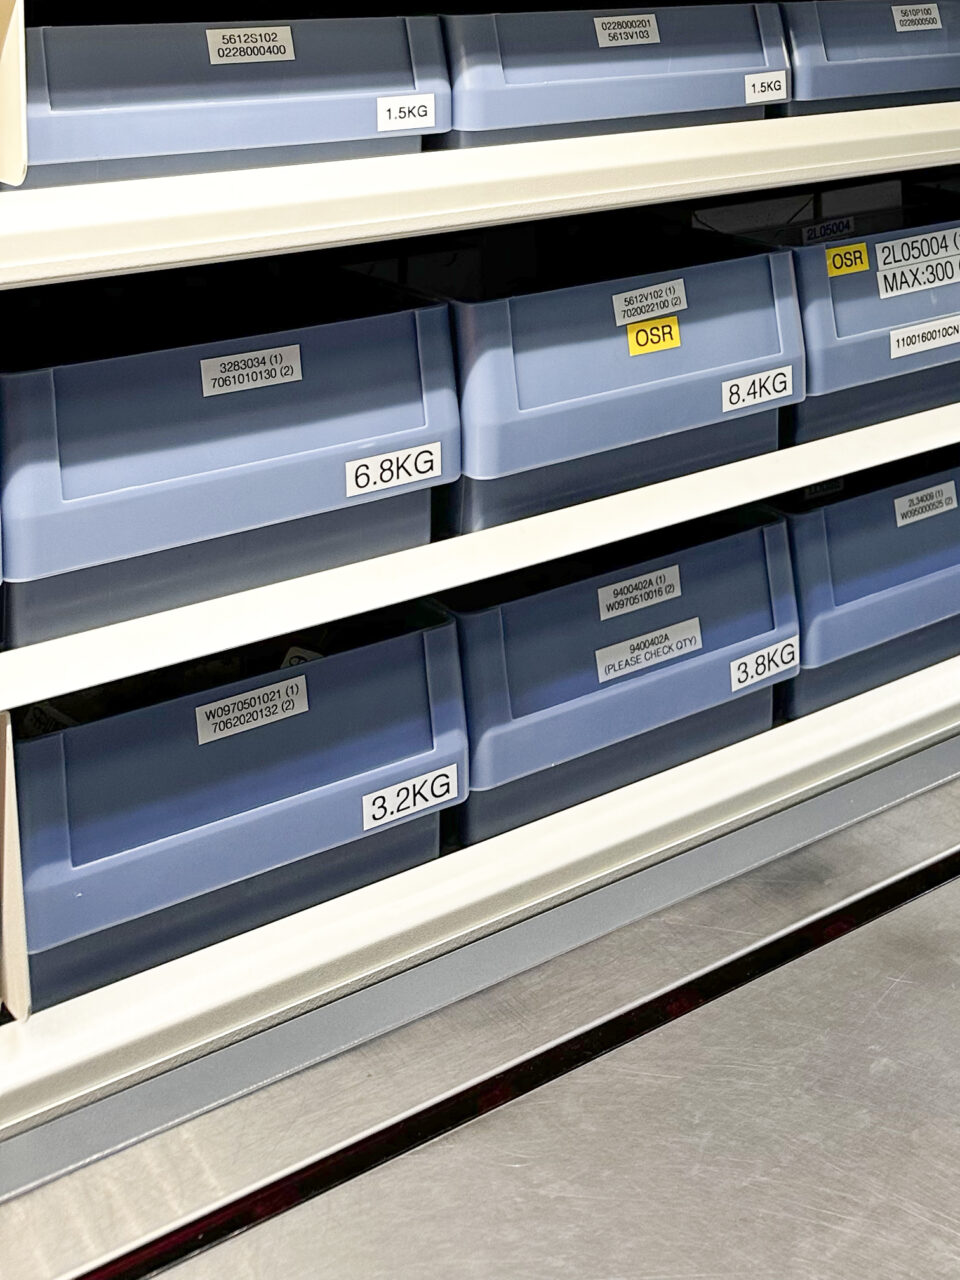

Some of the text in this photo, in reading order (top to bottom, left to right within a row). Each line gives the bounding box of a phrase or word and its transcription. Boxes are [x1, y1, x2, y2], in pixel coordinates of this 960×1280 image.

[601, 19, 651, 32] 0228000201
[607, 29, 650, 42] 5613V103
[217, 44, 287, 58] 0228000400
[221, 32, 279, 45] 5612S102
[751, 79, 782, 95] 1.5KG
[385, 104, 428, 121] 1.5KG
[832, 251, 864, 270] OSR
[881, 234, 949, 266] 2L05004
[883, 261, 955, 294] MAX:300
[621, 296, 682, 319] 7020022100 (2)
[624, 285, 676, 308] 5612V102 (1)
[635, 323, 674, 348] OSR
[896, 324, 960, 350] 1100160010CN
[219, 352, 283, 374] 3283034 (1)
[211, 364, 294, 389] 7061010130 (2)
[728, 372, 787, 406] 8.4KG
[354, 450, 435, 490] 6.8KG
[935, 488, 944, 499] (1)
[606, 582, 675, 613] W0970510016 (2)
[612, 574, 666, 599] 9400402A (1)
[604, 635, 697, 676] (PLEASE CHECK QTY)
[629, 633, 670, 655] 9400402A
[737, 643, 795, 684] 3.8KG
[204, 683, 300, 722] W0970501021 (1)
[211, 698, 295, 734] 7062020132 (2)
[371, 773, 451, 821] 3.2KG
